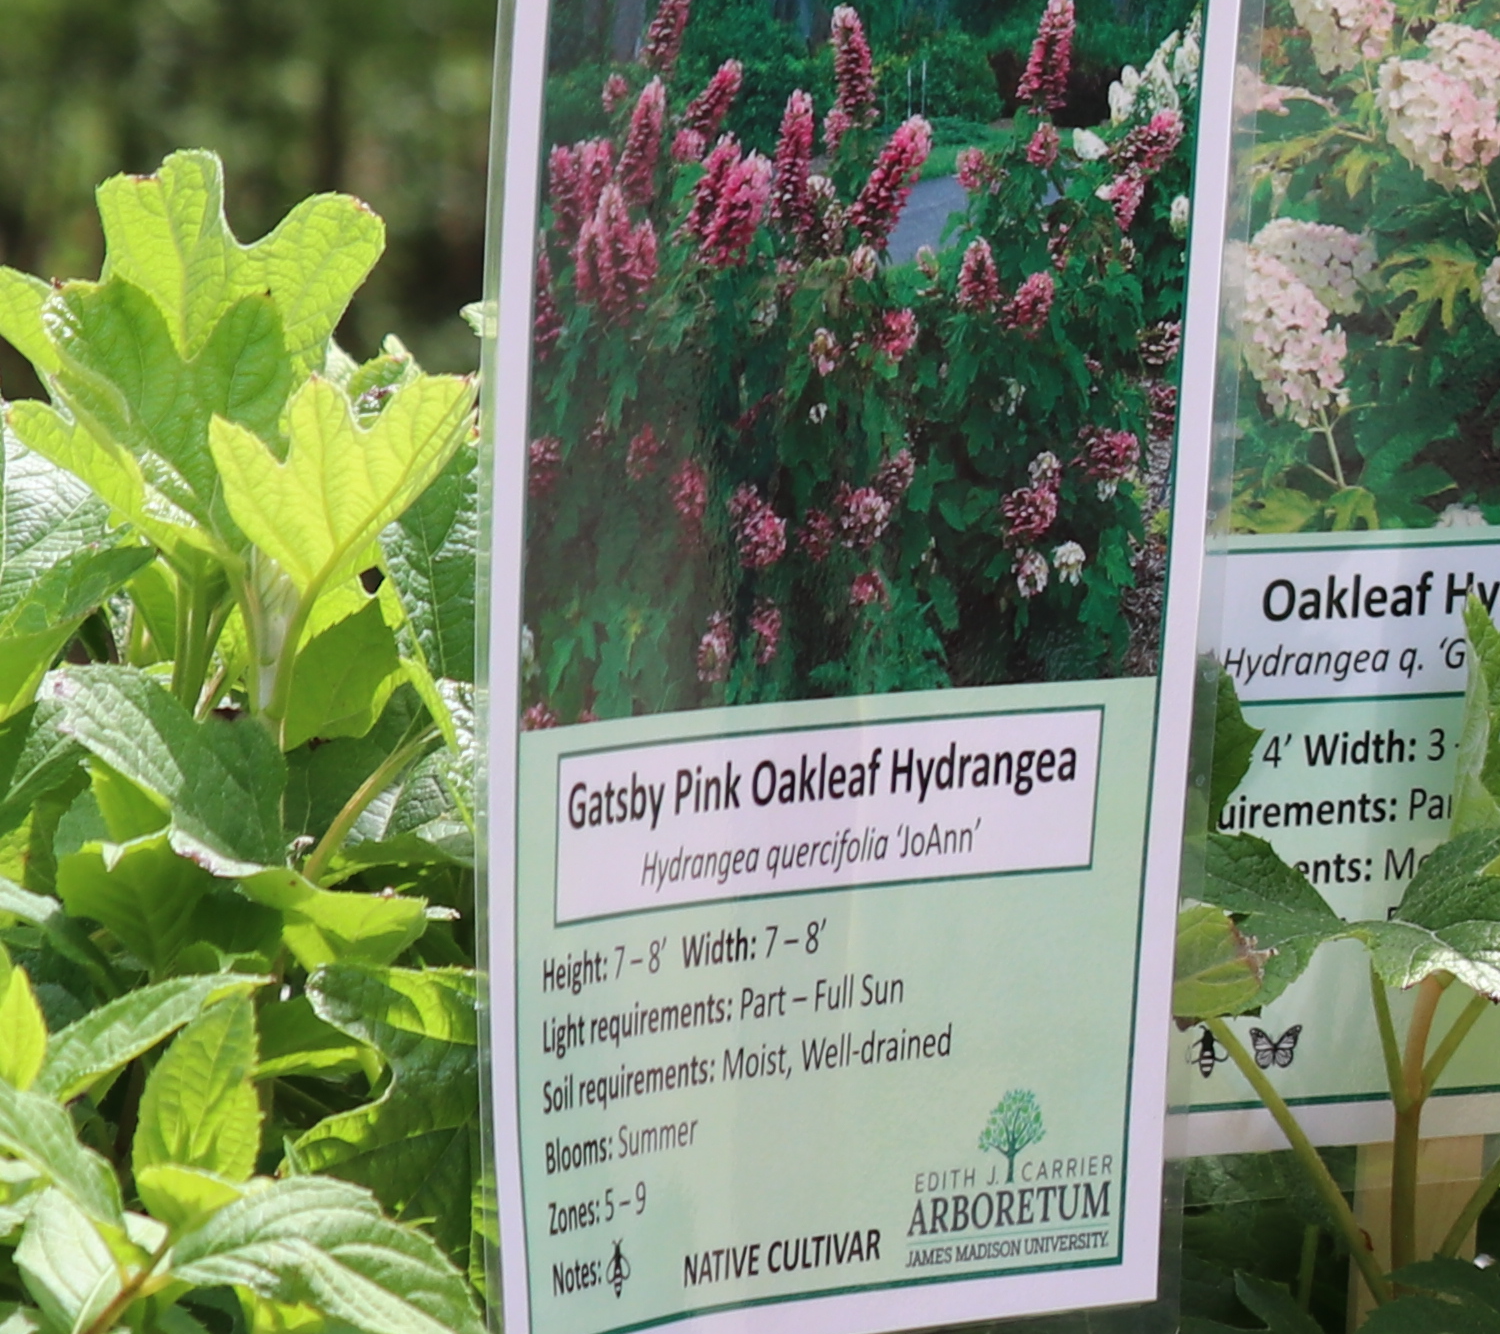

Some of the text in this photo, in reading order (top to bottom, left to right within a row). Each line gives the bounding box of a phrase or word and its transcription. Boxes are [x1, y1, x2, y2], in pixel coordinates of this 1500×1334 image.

[1261, 571, 1433, 623] Oakleaf
[1224, 644, 1389, 686] Hydrangea
[1400, 646, 1424, 679] q.
[1304, 729, 1416, 767] Width:
[1427, 728, 1445, 760] 3
[567, 742, 1078, 831] Gatsby Pink Oakleaf Hydrangea
[1217, 794, 1397, 831] uirements:
[640, 836, 760, 889] Hydrangea
[765, 826, 889, 876] quercifolia
[541, 950, 608, 996] Height:
[613, 945, 625, 980] 7
[681, 933, 757, 968] Width:
[764, 925, 779, 958] 7
[541, 973, 905, 1058] Light requirements: Part Full Sun
[541, 1023, 953, 1116] Soil requirements: Moist, Well-drained
[544, 1117, 698, 1175] Blooms: Summer
[914, 1156, 1114, 1193] EDITH J. CARRIER
[547, 1182, 648, 1237] Zones: 5 9
[907, 1181, 1112, 1239] ARBORETUM
[551, 1259, 602, 1298] Notes:
[683, 1229, 881, 1289] NATIVE CULTIVAR
[906, 1246, 954, 1269] JAMES
[956, 1238, 1020, 1264] MADISON
